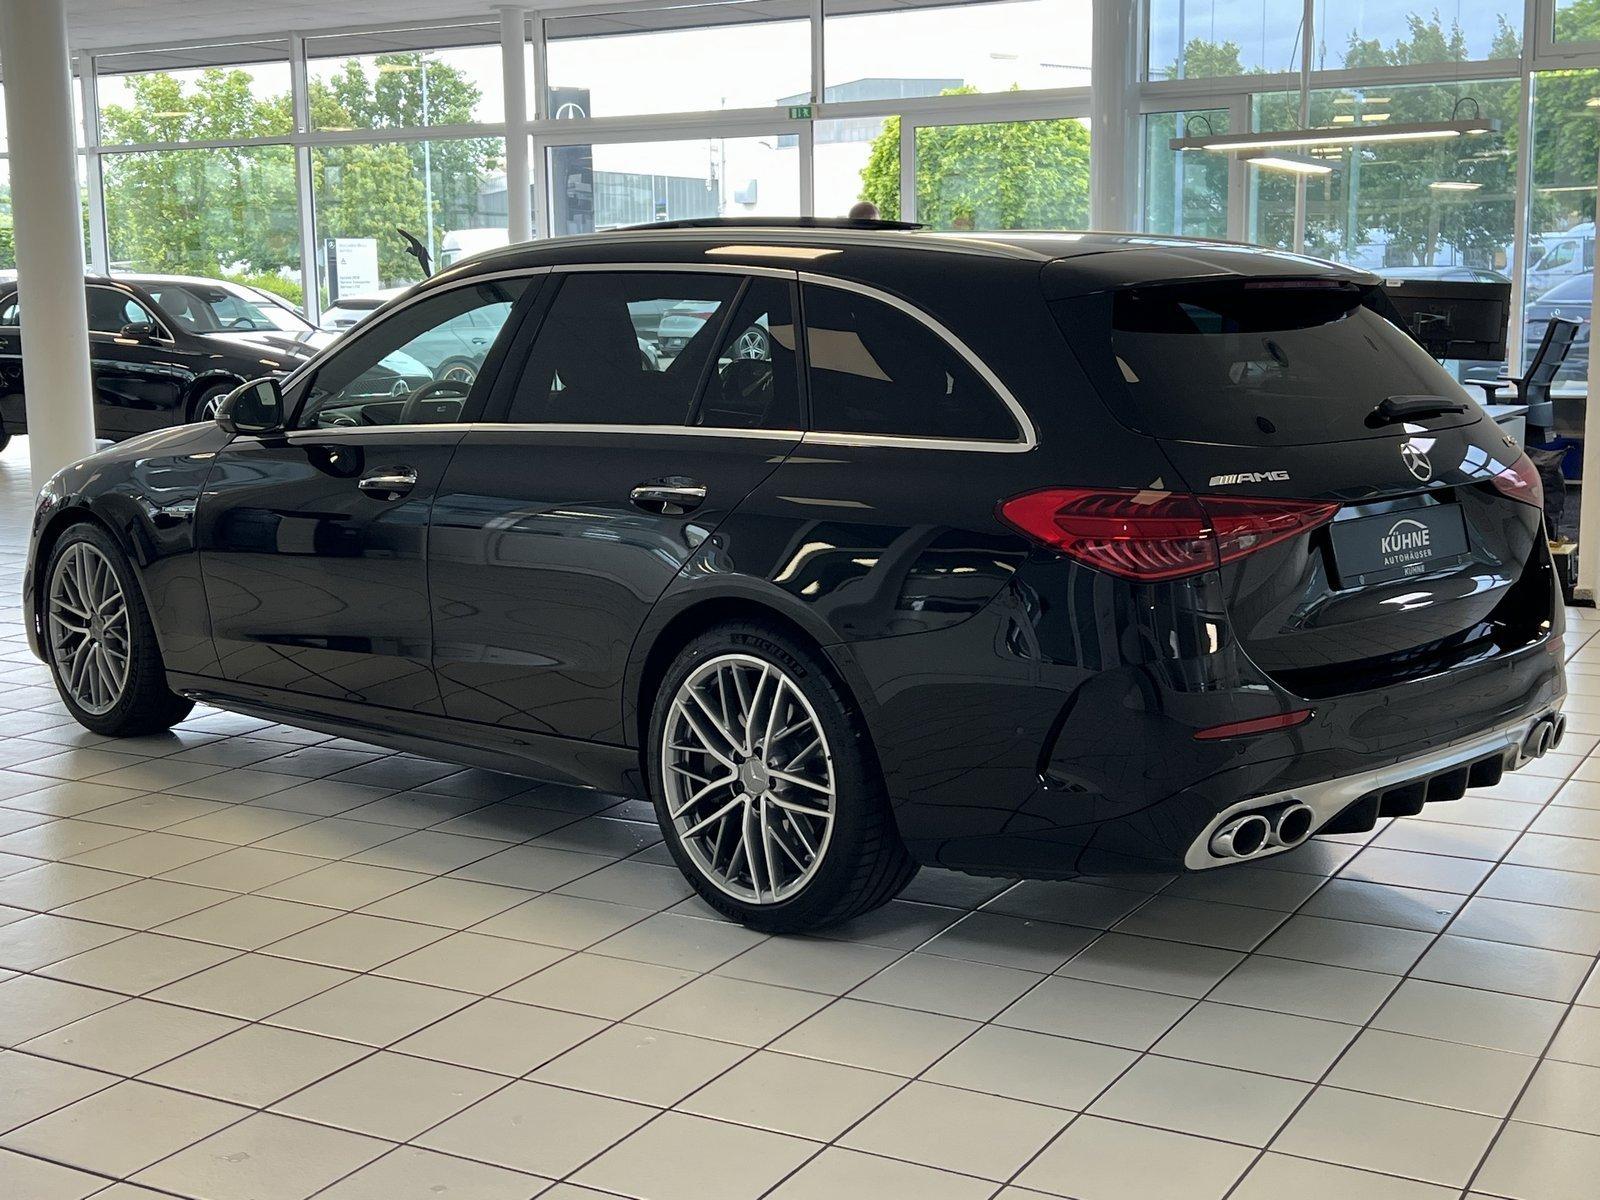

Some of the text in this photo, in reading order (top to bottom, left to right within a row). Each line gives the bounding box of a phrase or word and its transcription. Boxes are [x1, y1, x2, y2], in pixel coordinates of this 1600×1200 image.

[1236, 470, 1290, 484] AMG
[1381, 529, 1429, 553] KÜHNE
[1384, 549, 1432, 565] AUTOHÄUSER
